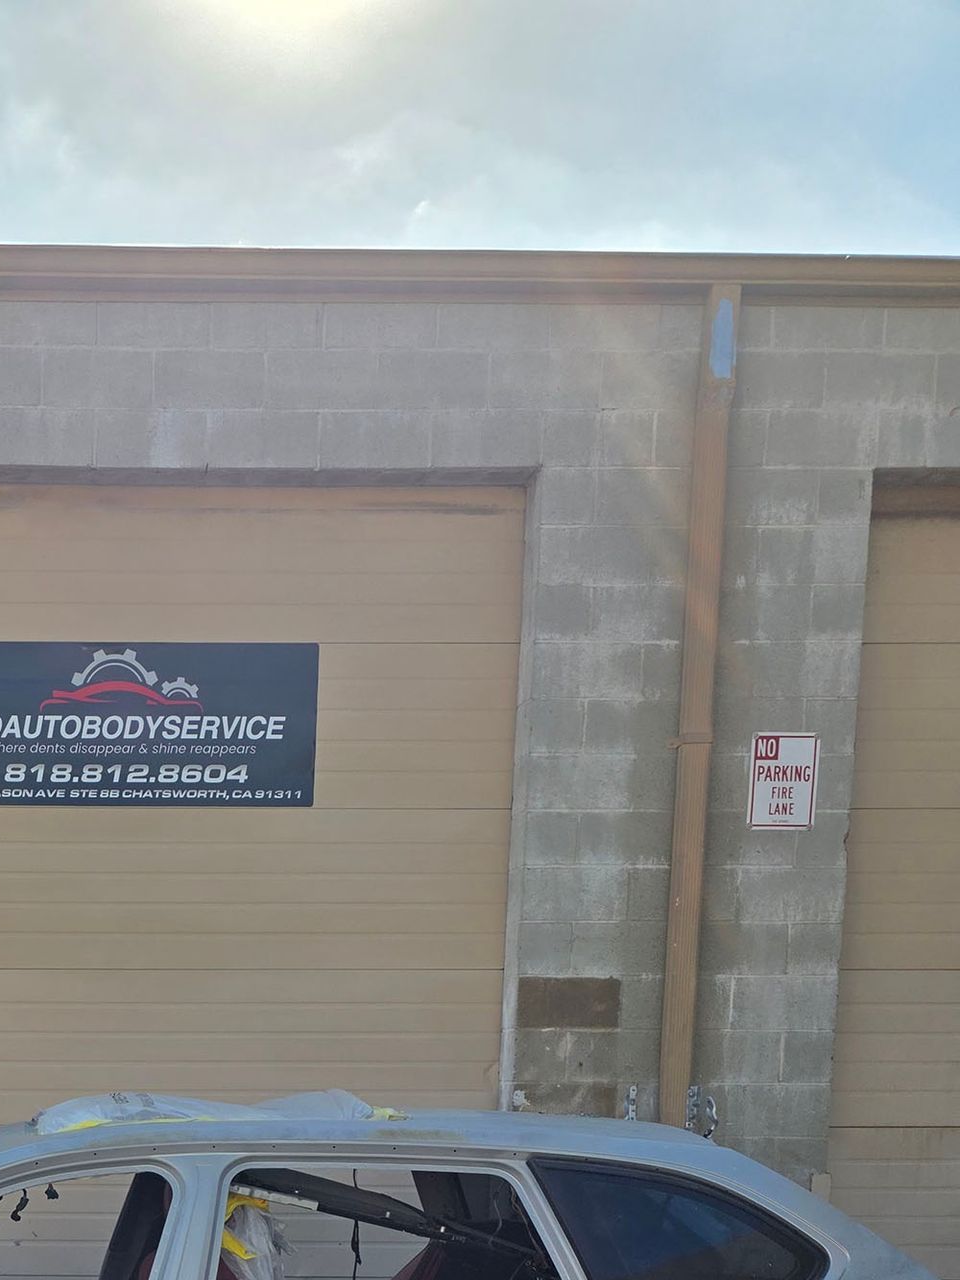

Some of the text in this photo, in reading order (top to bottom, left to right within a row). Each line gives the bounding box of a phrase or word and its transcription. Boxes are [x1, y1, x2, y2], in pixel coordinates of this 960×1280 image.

[29, 742, 66, 754] dents
[69, 742, 136, 758] disappear
[138, 743, 148, 754] &
[152, 743, 187, 755] shine
[190, 744, 257, 758] reappears
[756, 739, 776, 757] NO
[4, 763, 249, 783] 818.812.8604
[757, 765, 811, 783] PARKING
[35, 788, 66, 798] AVE
[70, 789, 98, 798] STE
[99, 789, 120, 798] 8B
[122, 789, 230, 800] CHATSWORTH,
[232, 789, 253, 799] CA
[254, 789, 302, 799] 91311
[771, 786, 794, 799] FIRE
[768, 802, 795, 816] LANE
